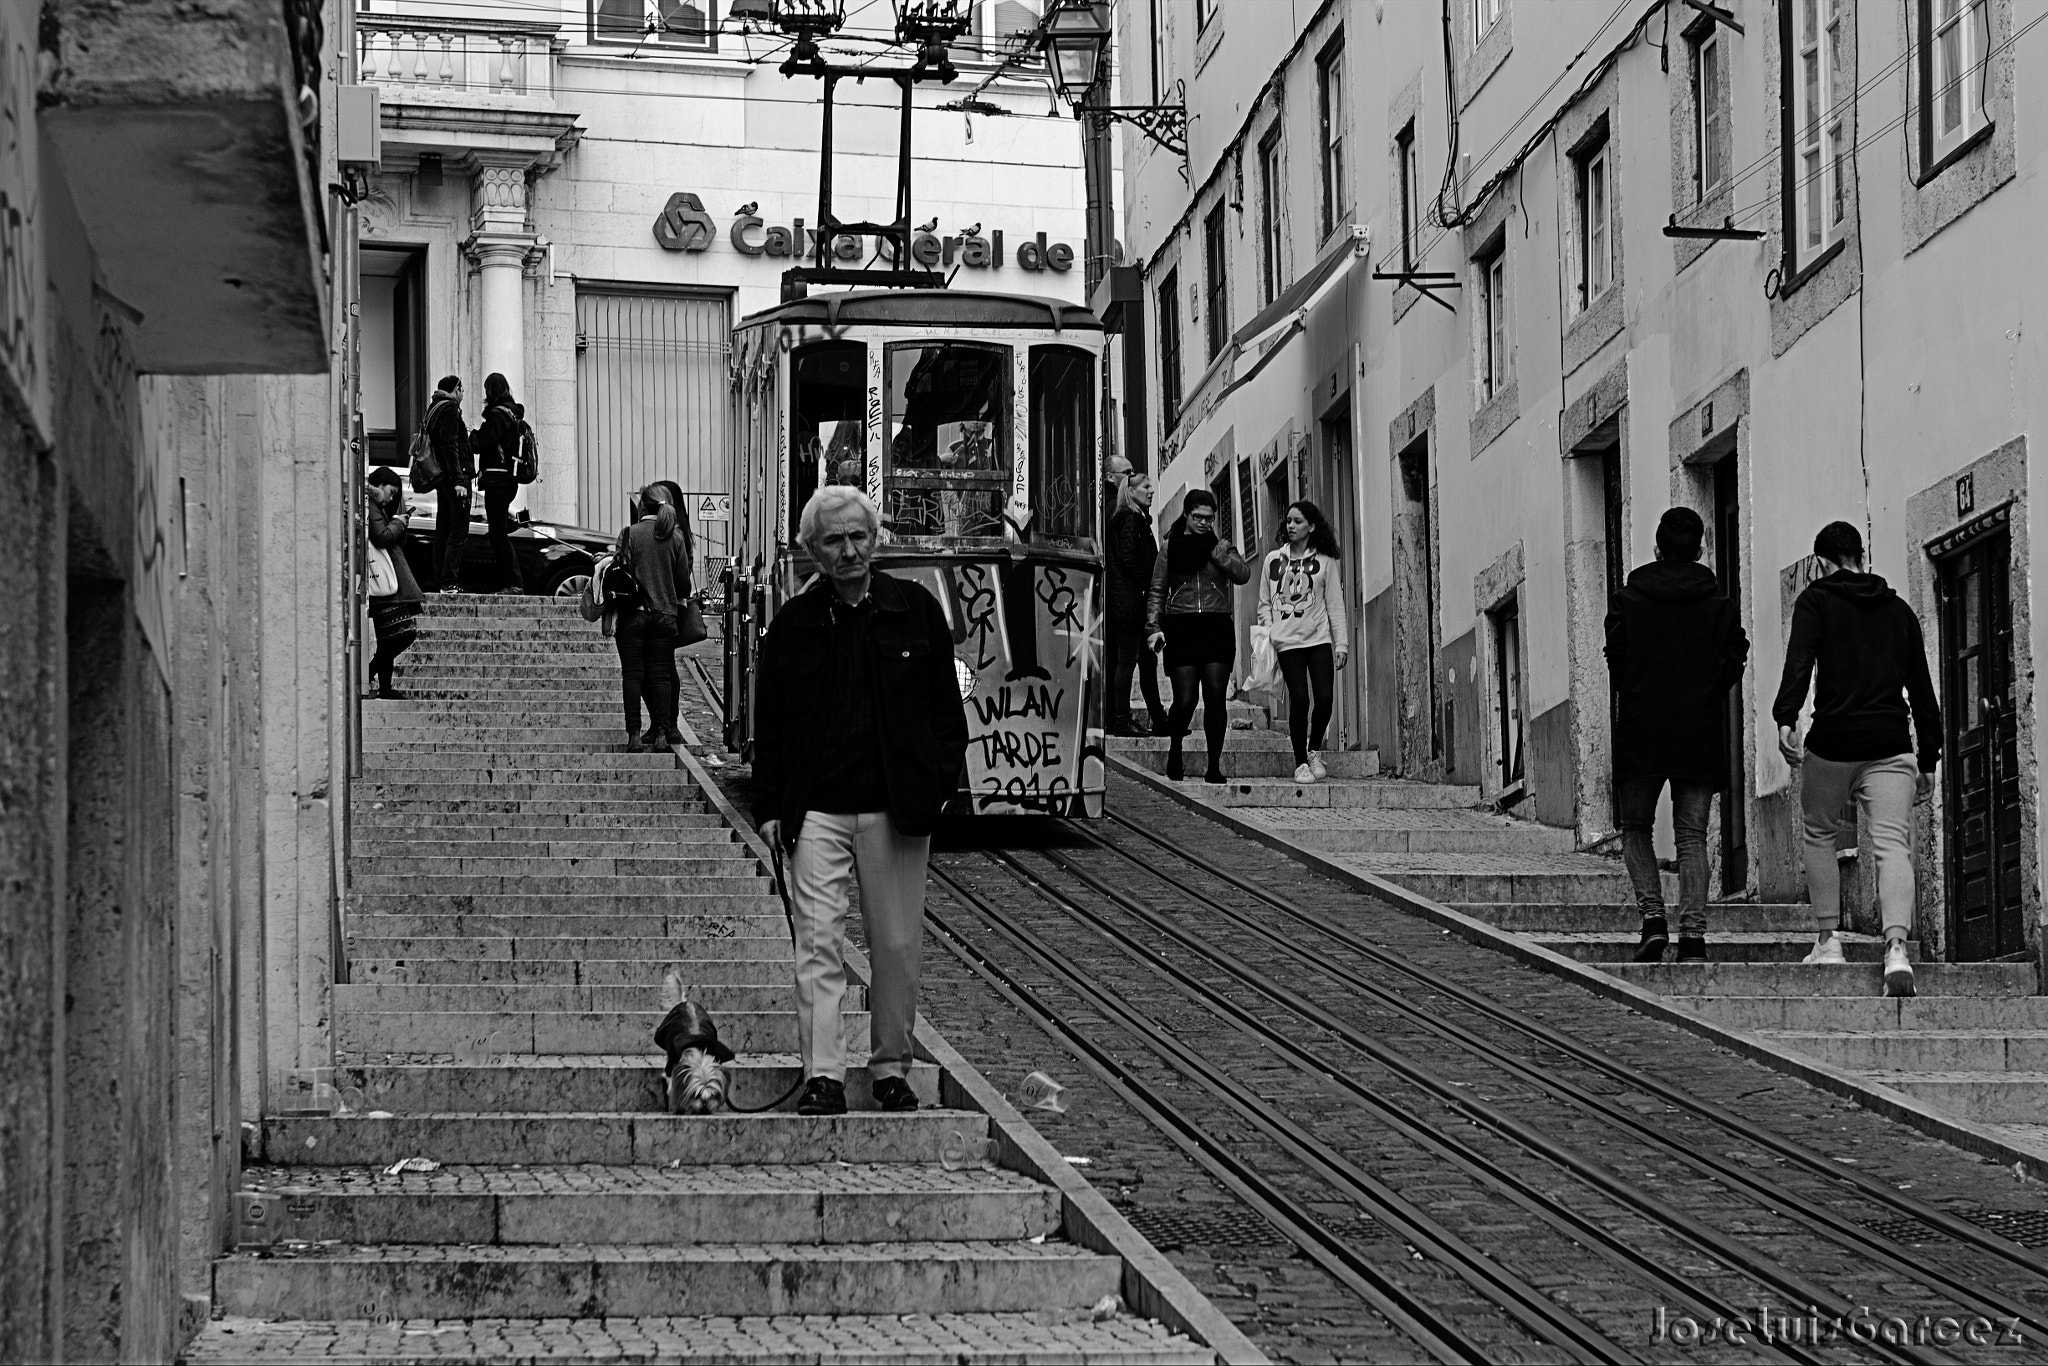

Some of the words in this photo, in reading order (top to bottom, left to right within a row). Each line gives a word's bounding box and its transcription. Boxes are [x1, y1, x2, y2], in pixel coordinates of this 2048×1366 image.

[1016, 232, 1075, 273] de
[972, 685, 1065, 725] WLAN
[969, 730, 1062, 769] TARDE
